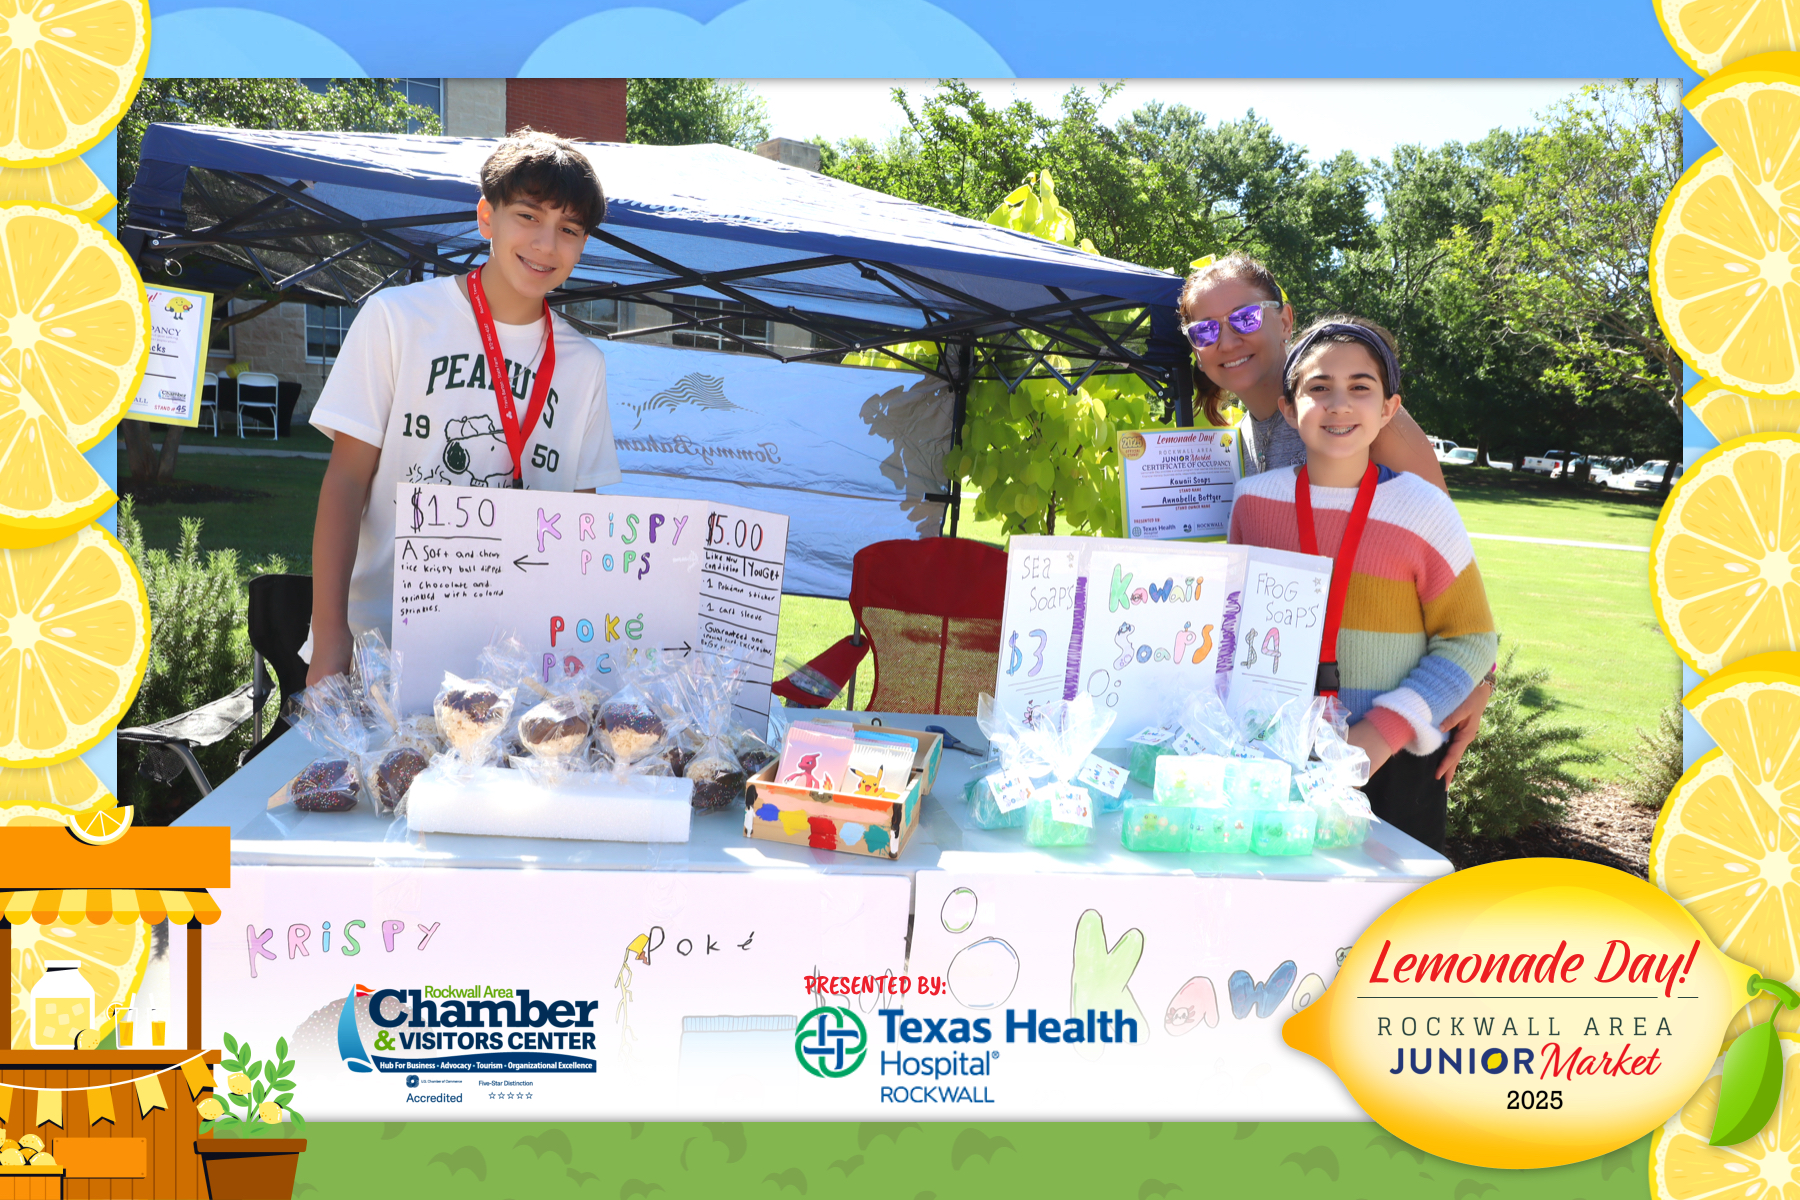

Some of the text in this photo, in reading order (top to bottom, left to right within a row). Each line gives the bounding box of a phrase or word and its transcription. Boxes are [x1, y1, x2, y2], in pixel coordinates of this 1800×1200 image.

[176, 404, 187, 413] 45
[402, 412, 431, 440] 19
[1156, 433, 1197, 445] Lemonade
[530, 443, 561, 473] 50
[1158, 448, 1194, 456] ROCKWALL
[1161, 455, 1190, 463] JUNIOR
[1141, 462, 1187, 472] CERTIFICATE
[1187, 461, 1197, 469] OF
[1197, 459, 1232, 468] OCCUPANCY
[1169, 476, 1211, 486] Kawaii Soaps
[1162, 493, 1222, 505] Annabelle Bottger
[410, 487, 498, 534] $1.50
[705, 511, 764, 552] $5.00
[1142, 525, 1158, 533] Texas
[402, 539, 418, 560] A
[455, 549, 475, 560] and
[706, 551, 723, 562] Like
[401, 562, 418, 573] rice
[459, 565, 477, 574] ball
[579, 549, 652, 581] POPS
[402, 579, 491, 590] in chocolate and
[444, 590, 468, 599] with
[748, 591, 776, 601] sticker
[719, 606, 736, 616] card
[740, 610, 763, 622] sleeve
[704, 621, 764, 644] Guaranteed one
[1005, 628, 1047, 677] $3
[1240, 626, 1282, 675] $4
